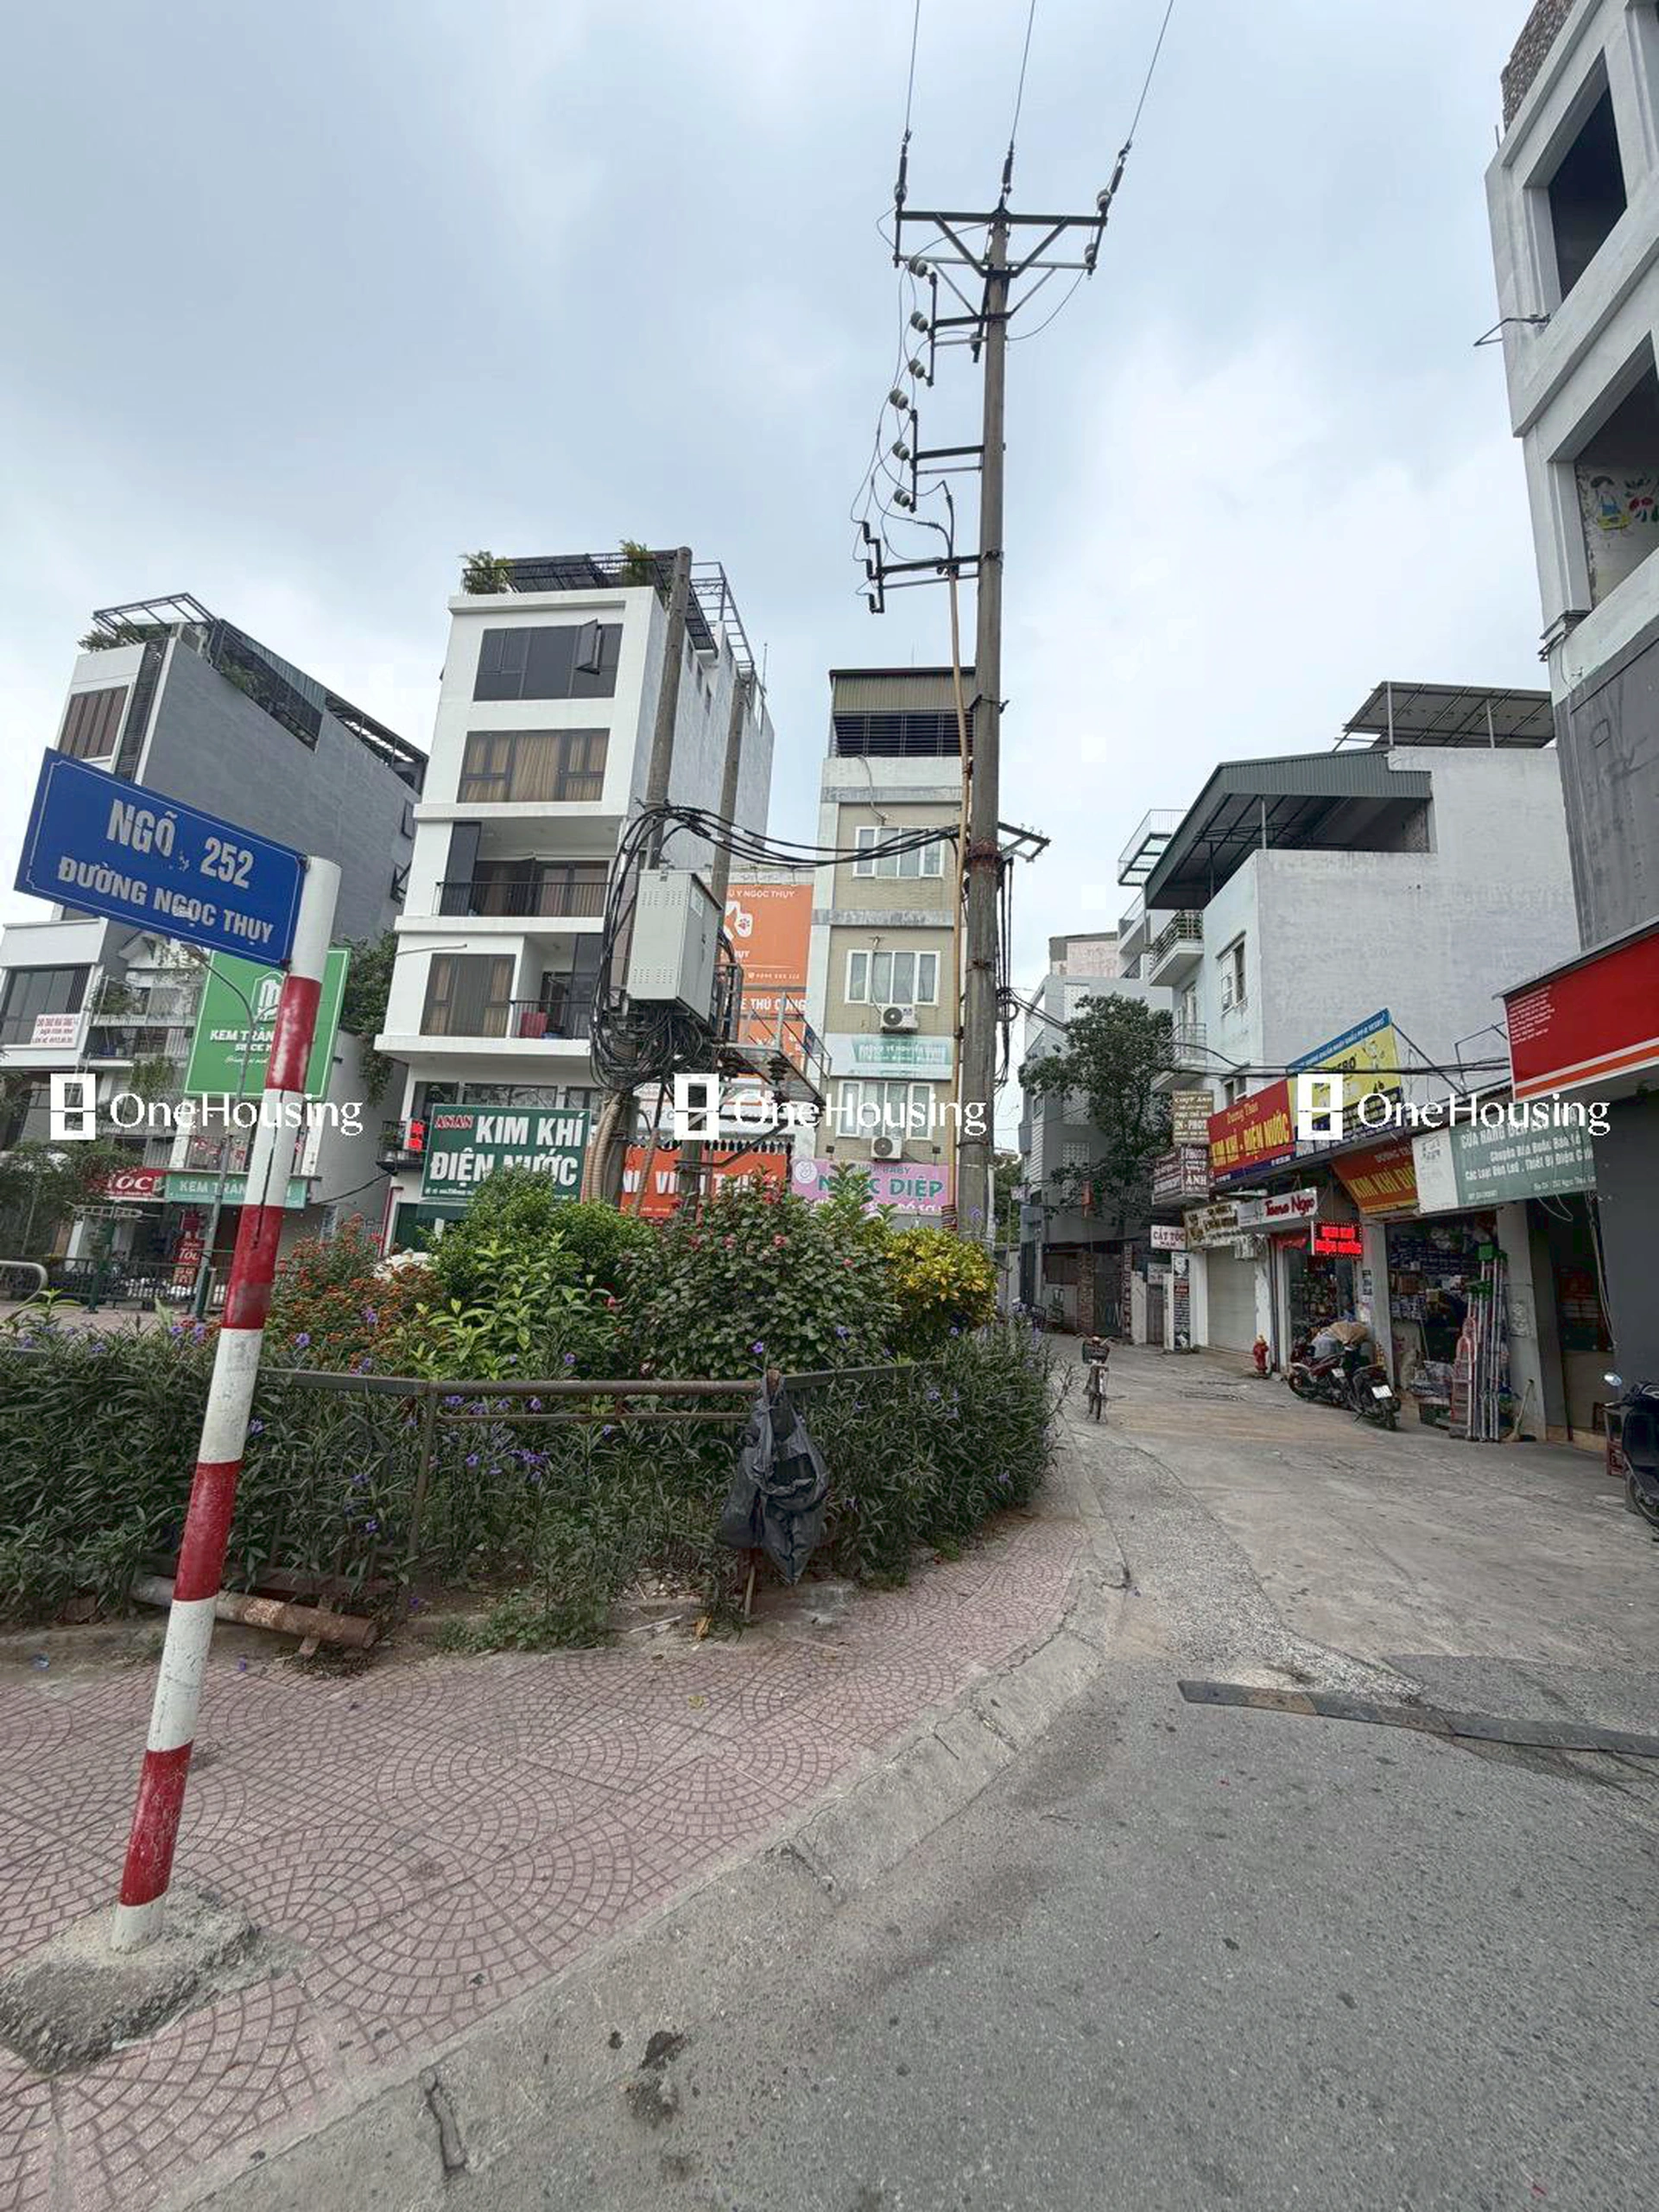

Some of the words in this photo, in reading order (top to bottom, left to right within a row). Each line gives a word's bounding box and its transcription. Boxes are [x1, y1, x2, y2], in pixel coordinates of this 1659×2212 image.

[107, 799, 178, 857] NGÕ
[200, 837, 254, 889] 252
[58, 856, 147, 904] ĐƯỜNG
[154, 887, 216, 928] NGỌC
[224, 910, 274, 945] THỤY
[210, 1030, 238, 1041] KEM
[475, 1115, 529, 1144] KIM
[536, 1112, 586, 1146] KHÍ
[430, 1147, 495, 1187] ĐIỆN
[180, 1180, 209, 1193] KEM
[890, 1176, 943, 1201] DIỆP
[1154, 1228, 1168, 1240] CẮT
[1170, 1229, 1185, 1241] TÓC
